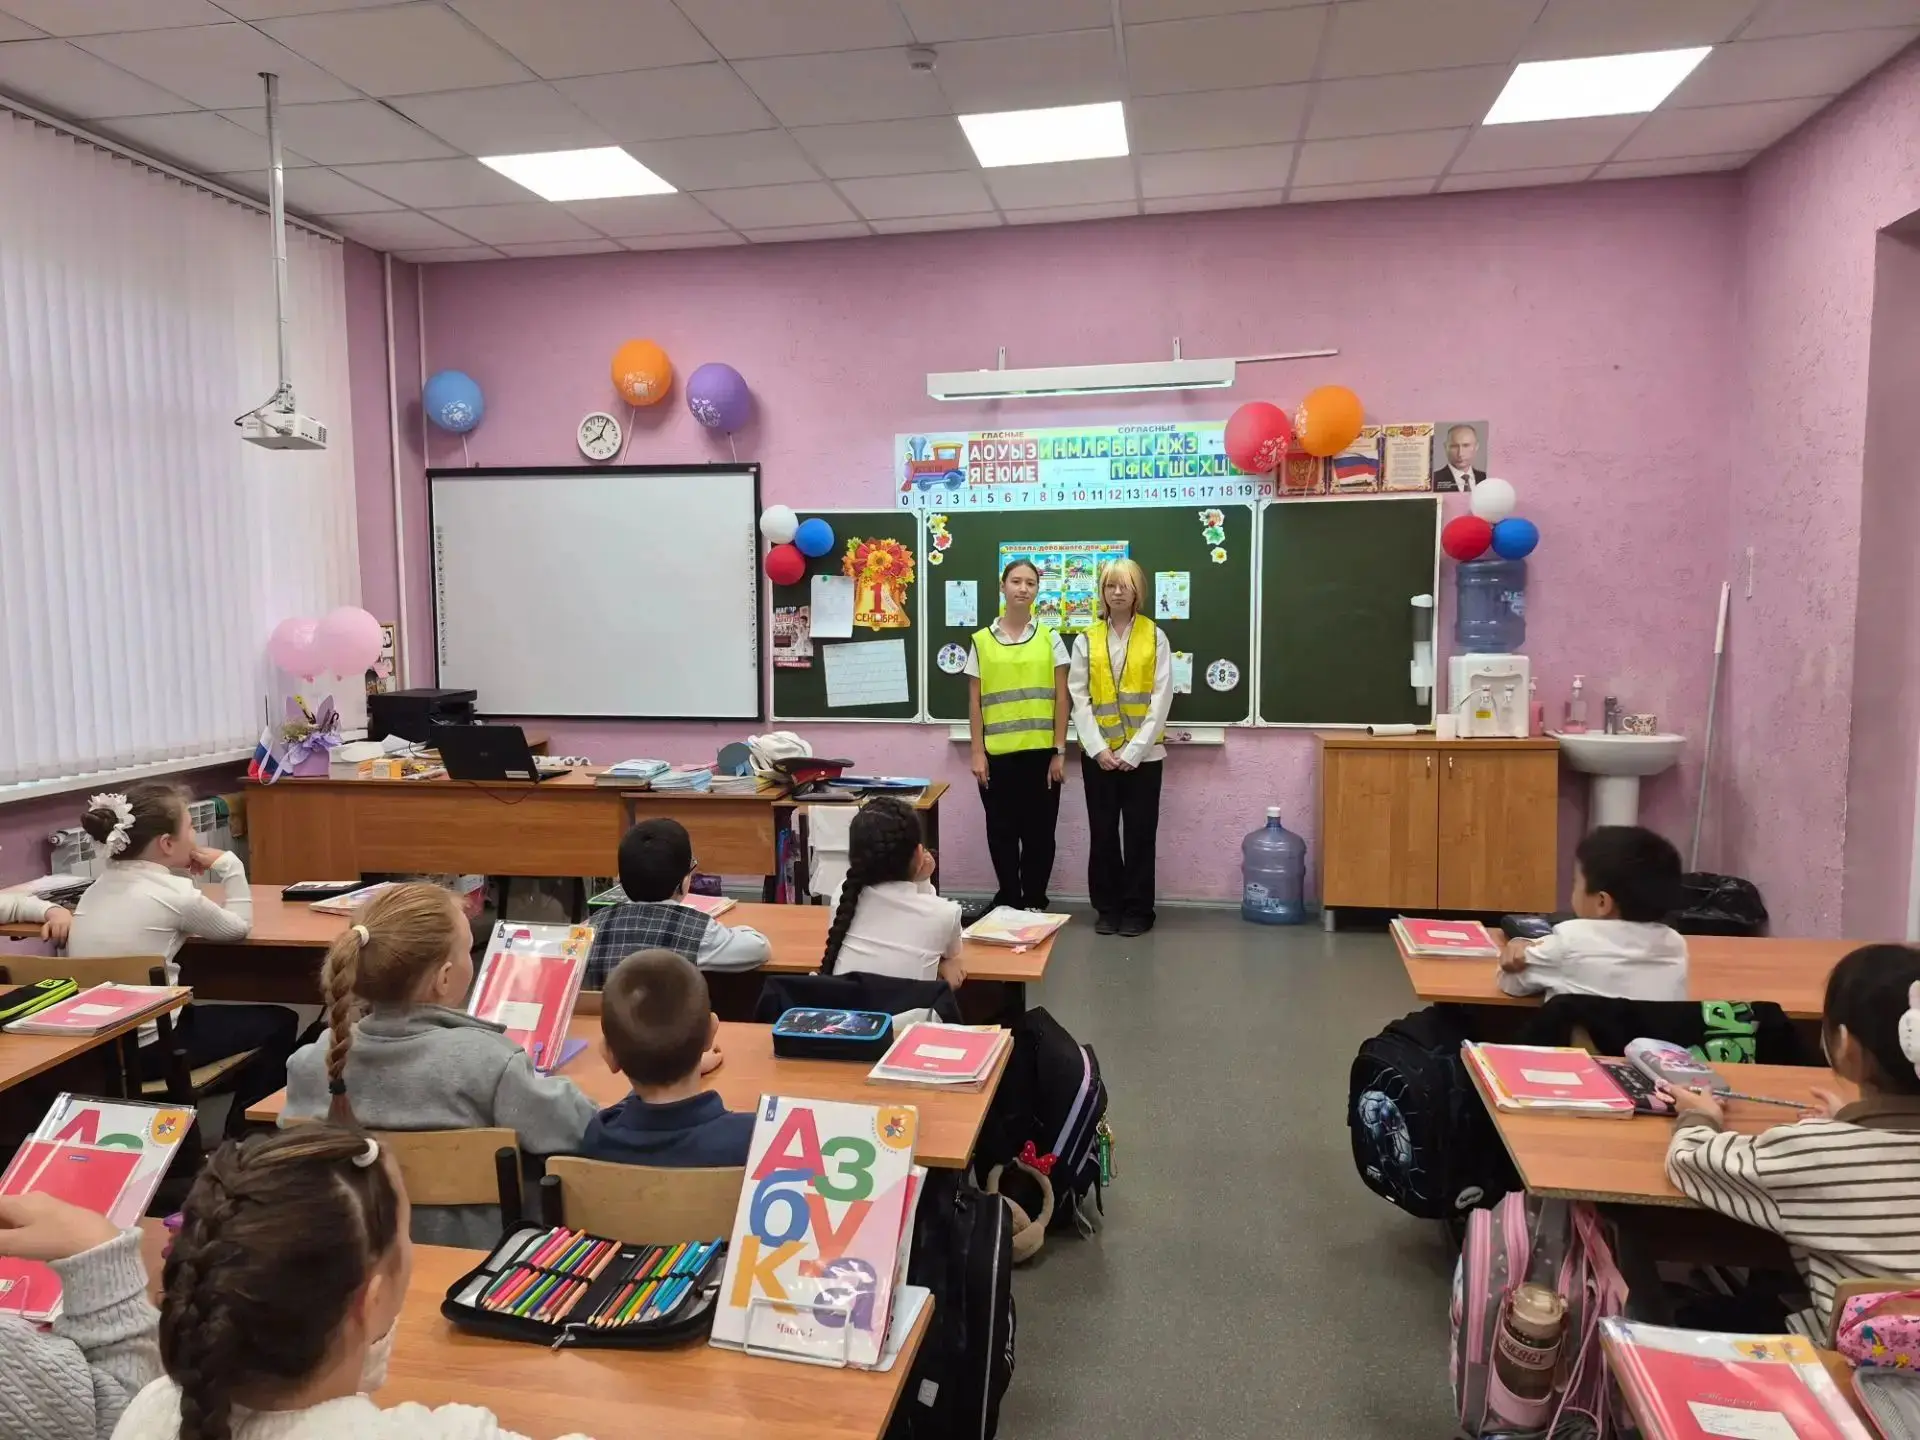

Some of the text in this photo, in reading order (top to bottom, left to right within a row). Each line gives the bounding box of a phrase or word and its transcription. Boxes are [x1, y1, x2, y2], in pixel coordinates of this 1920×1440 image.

[1118, 424, 1176, 434] СОГЛАСНЫЕ
[902, 484, 1272, 505] 0 1 2 3 4 5 6 7 8 9 10 11 12 13 14 15 16 17 18 19 20
[869, 583, 886, 613] 1
